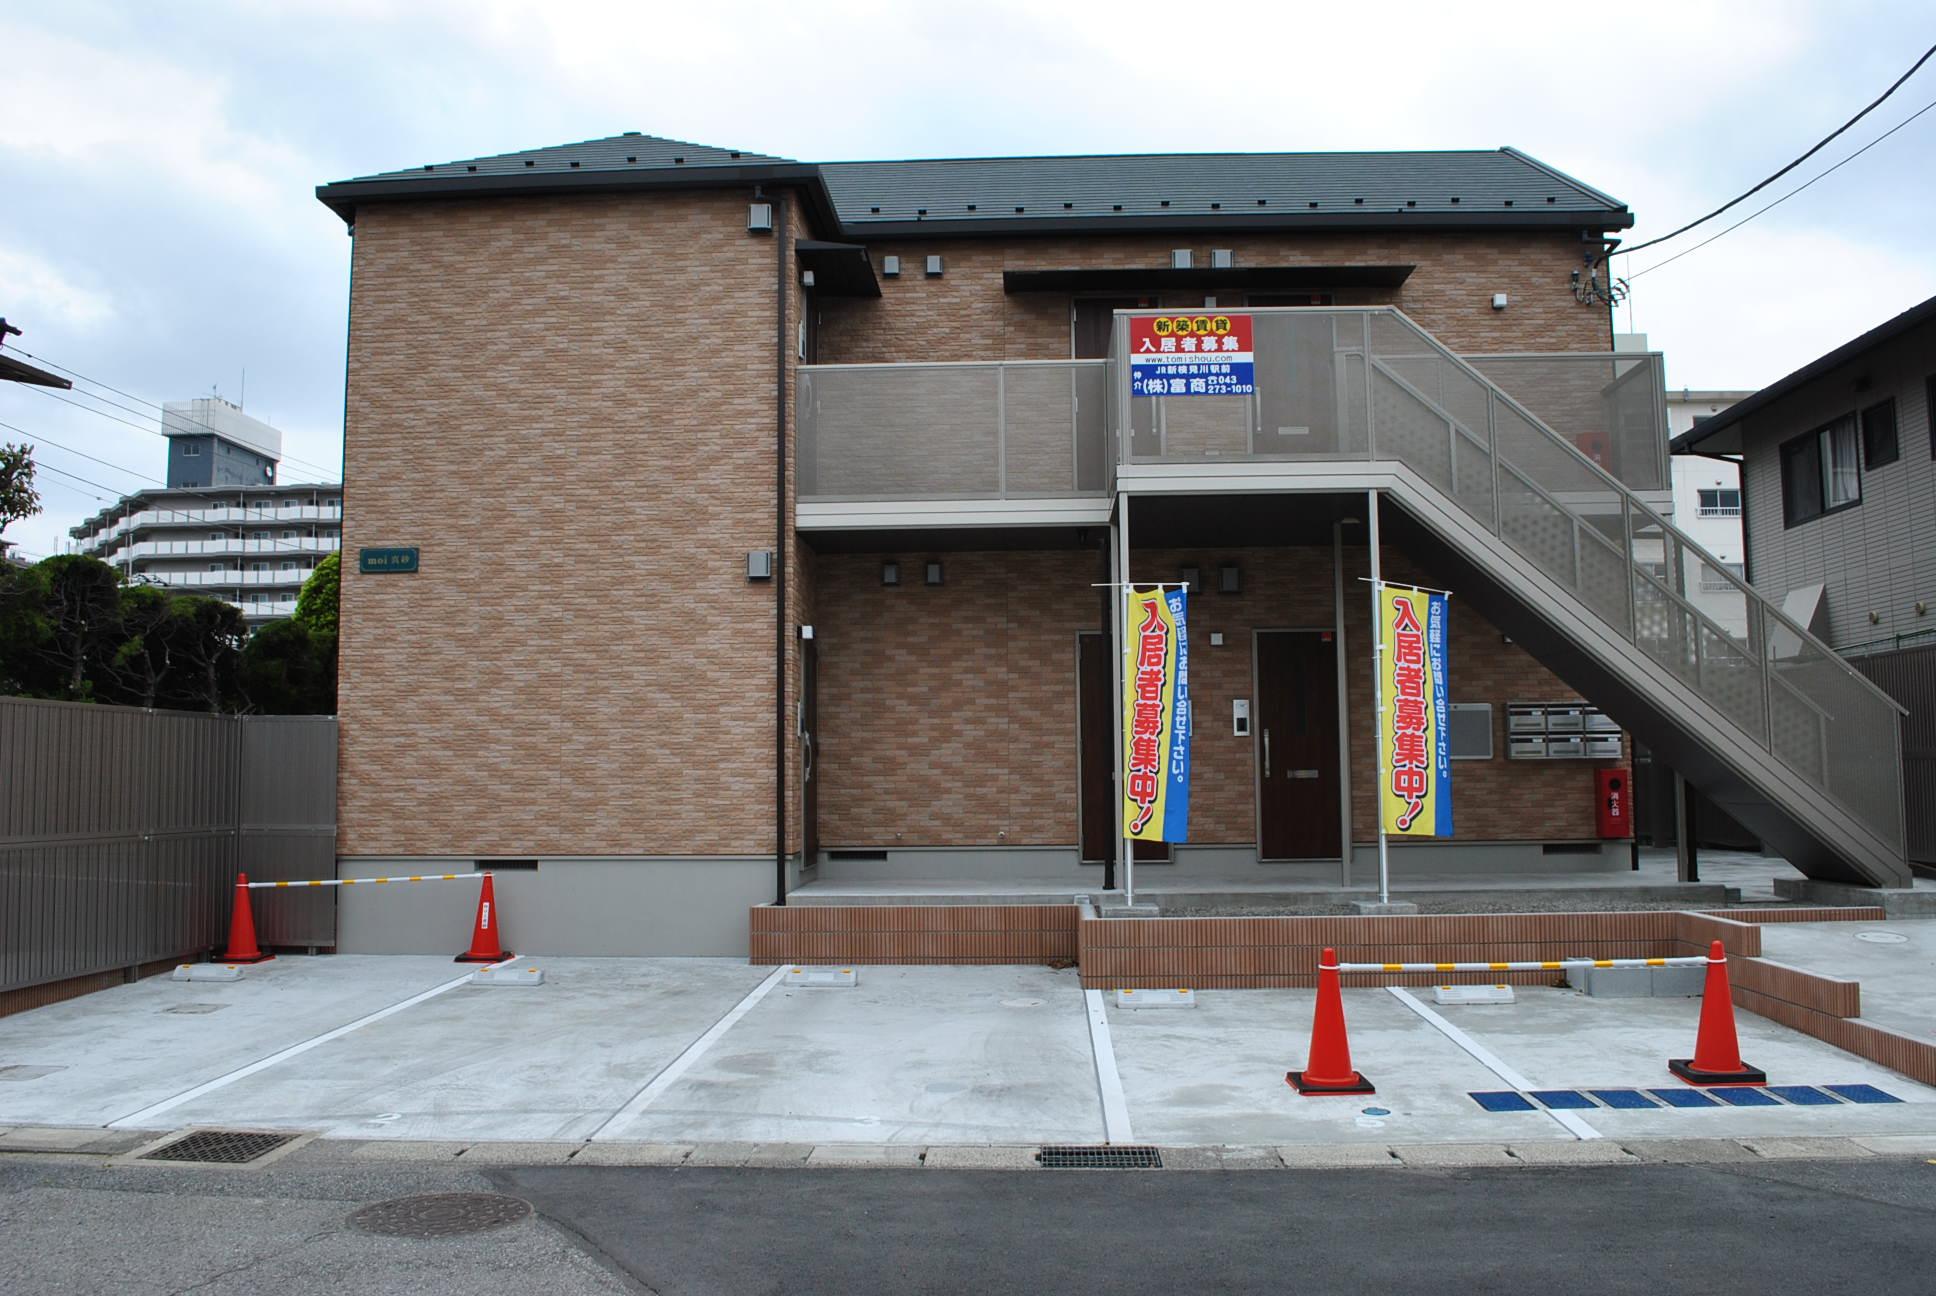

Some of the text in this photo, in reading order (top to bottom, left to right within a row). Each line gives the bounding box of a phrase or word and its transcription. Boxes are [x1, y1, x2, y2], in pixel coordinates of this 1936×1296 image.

[1155, 318, 1229, 332] 新築賃貸
[1139, 335, 1239, 352] 入居者募集
[1145, 354, 1232, 363] www.tomishou.com
[1155, 364, 1230, 374] JR新検見川駅前
[1143, 378, 1206, 394] (株)富商
[1207, 384, 1252, 394] 273-1010
[1610, 791, 1620, 816] 消火器
